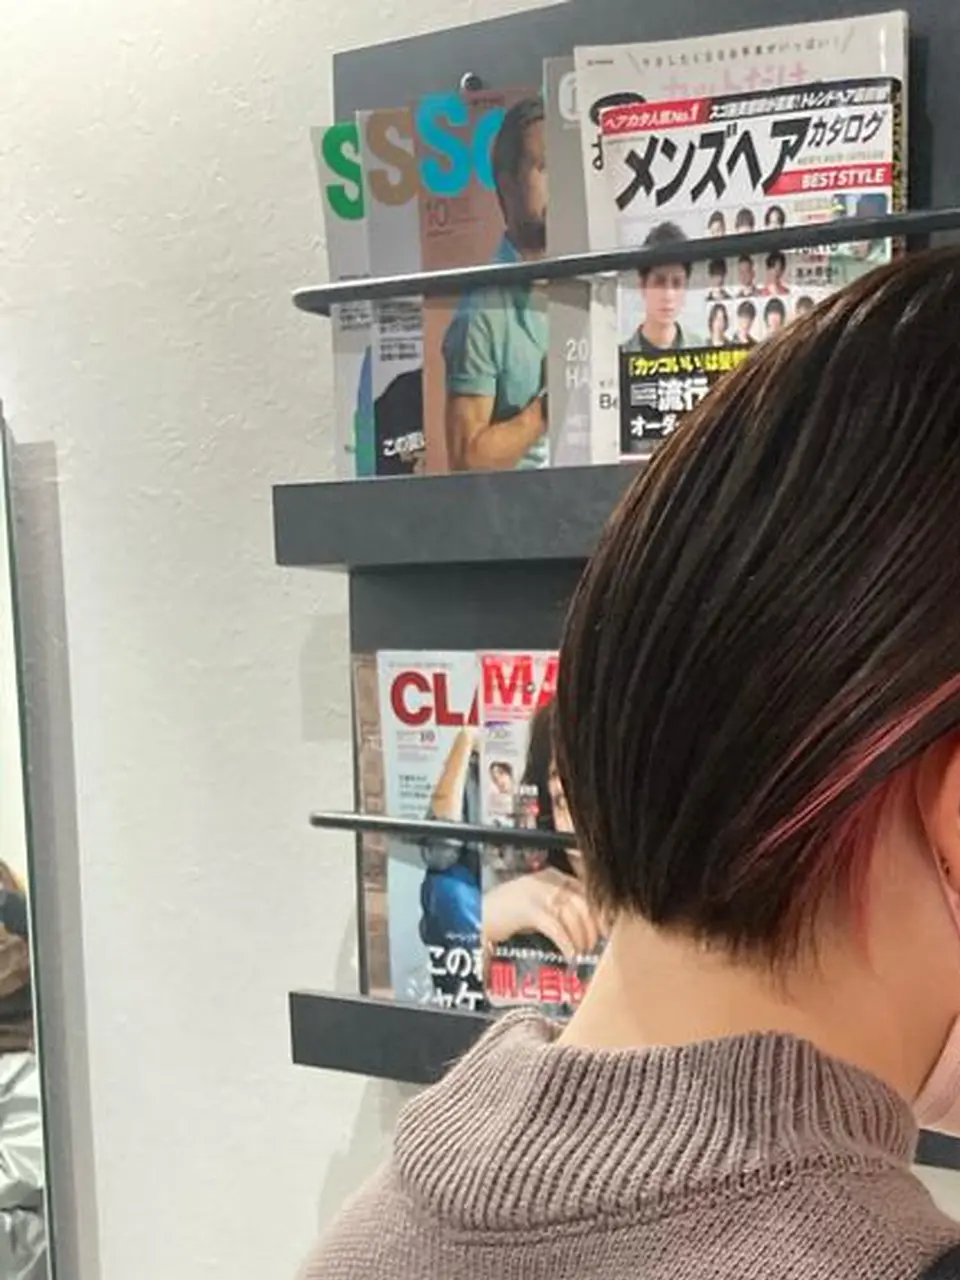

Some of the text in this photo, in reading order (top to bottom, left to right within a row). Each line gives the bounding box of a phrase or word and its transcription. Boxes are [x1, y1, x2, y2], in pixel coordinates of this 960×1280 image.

[808, 110, 888, 147] カタログ
[615, 116, 813, 212] メンズヘア
[801, 167, 884, 188] BEST STYLE
